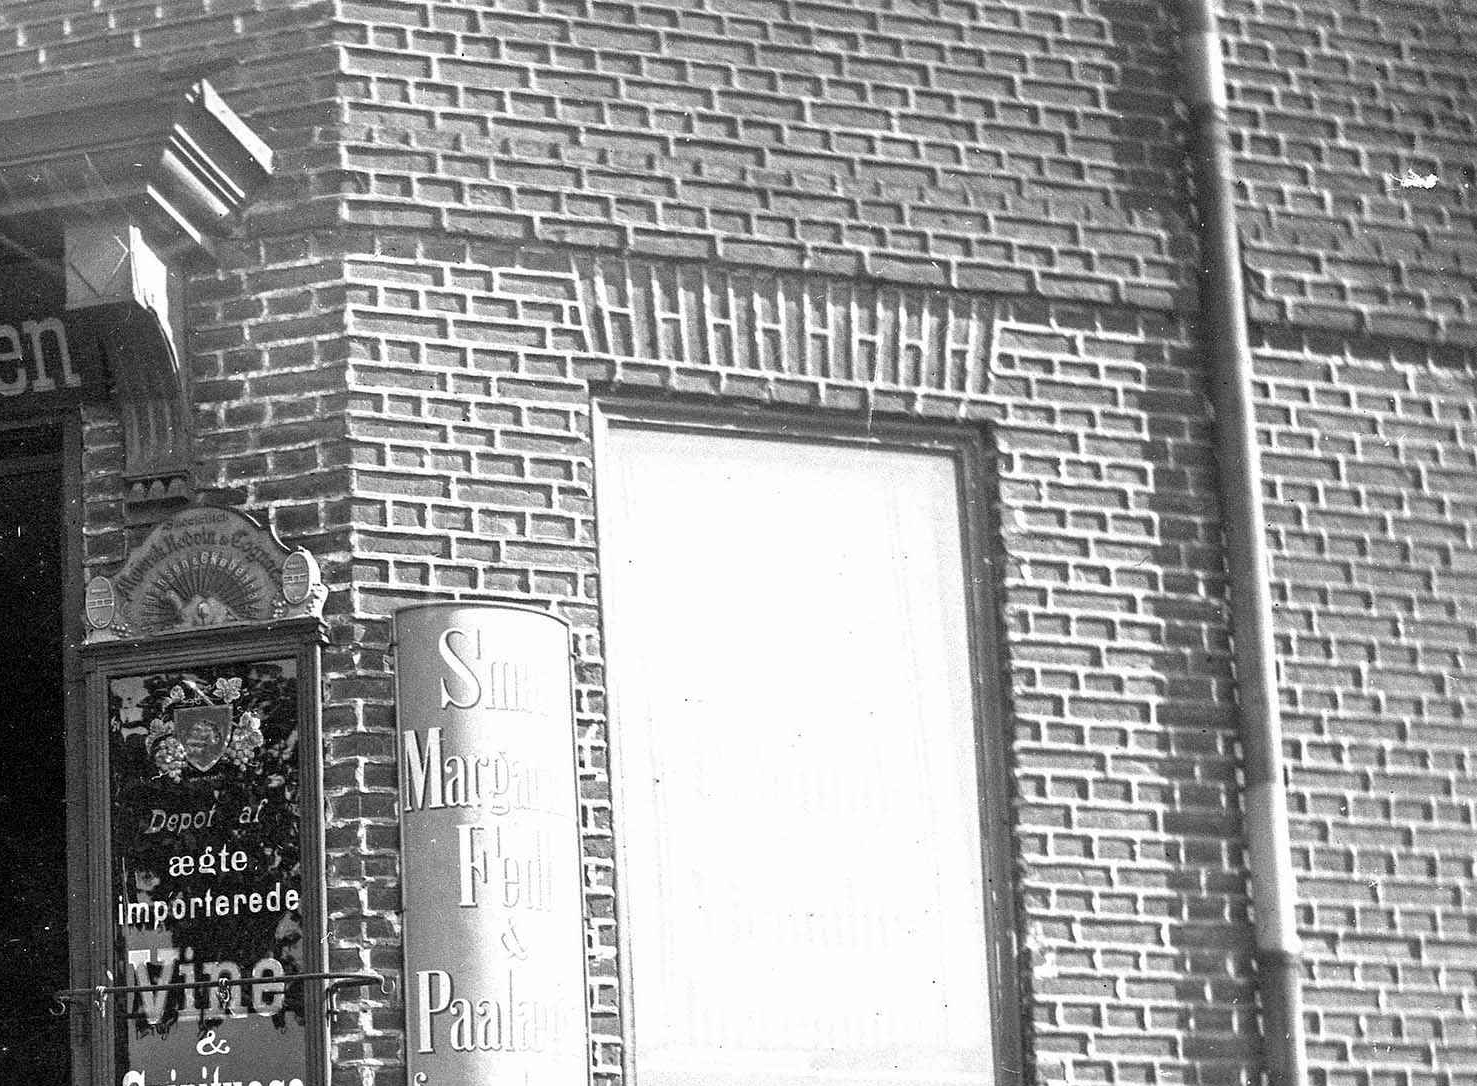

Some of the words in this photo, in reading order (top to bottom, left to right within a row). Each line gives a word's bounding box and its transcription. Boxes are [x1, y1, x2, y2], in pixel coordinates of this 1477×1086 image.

[144, 805, 217, 834] Depot
[239, 799, 268, 824] af
[168, 846, 248, 877] ægte
[118, 882, 299, 930] importerede
[128, 946, 285, 1025] Vine
[196, 1030, 230, 1055] &
